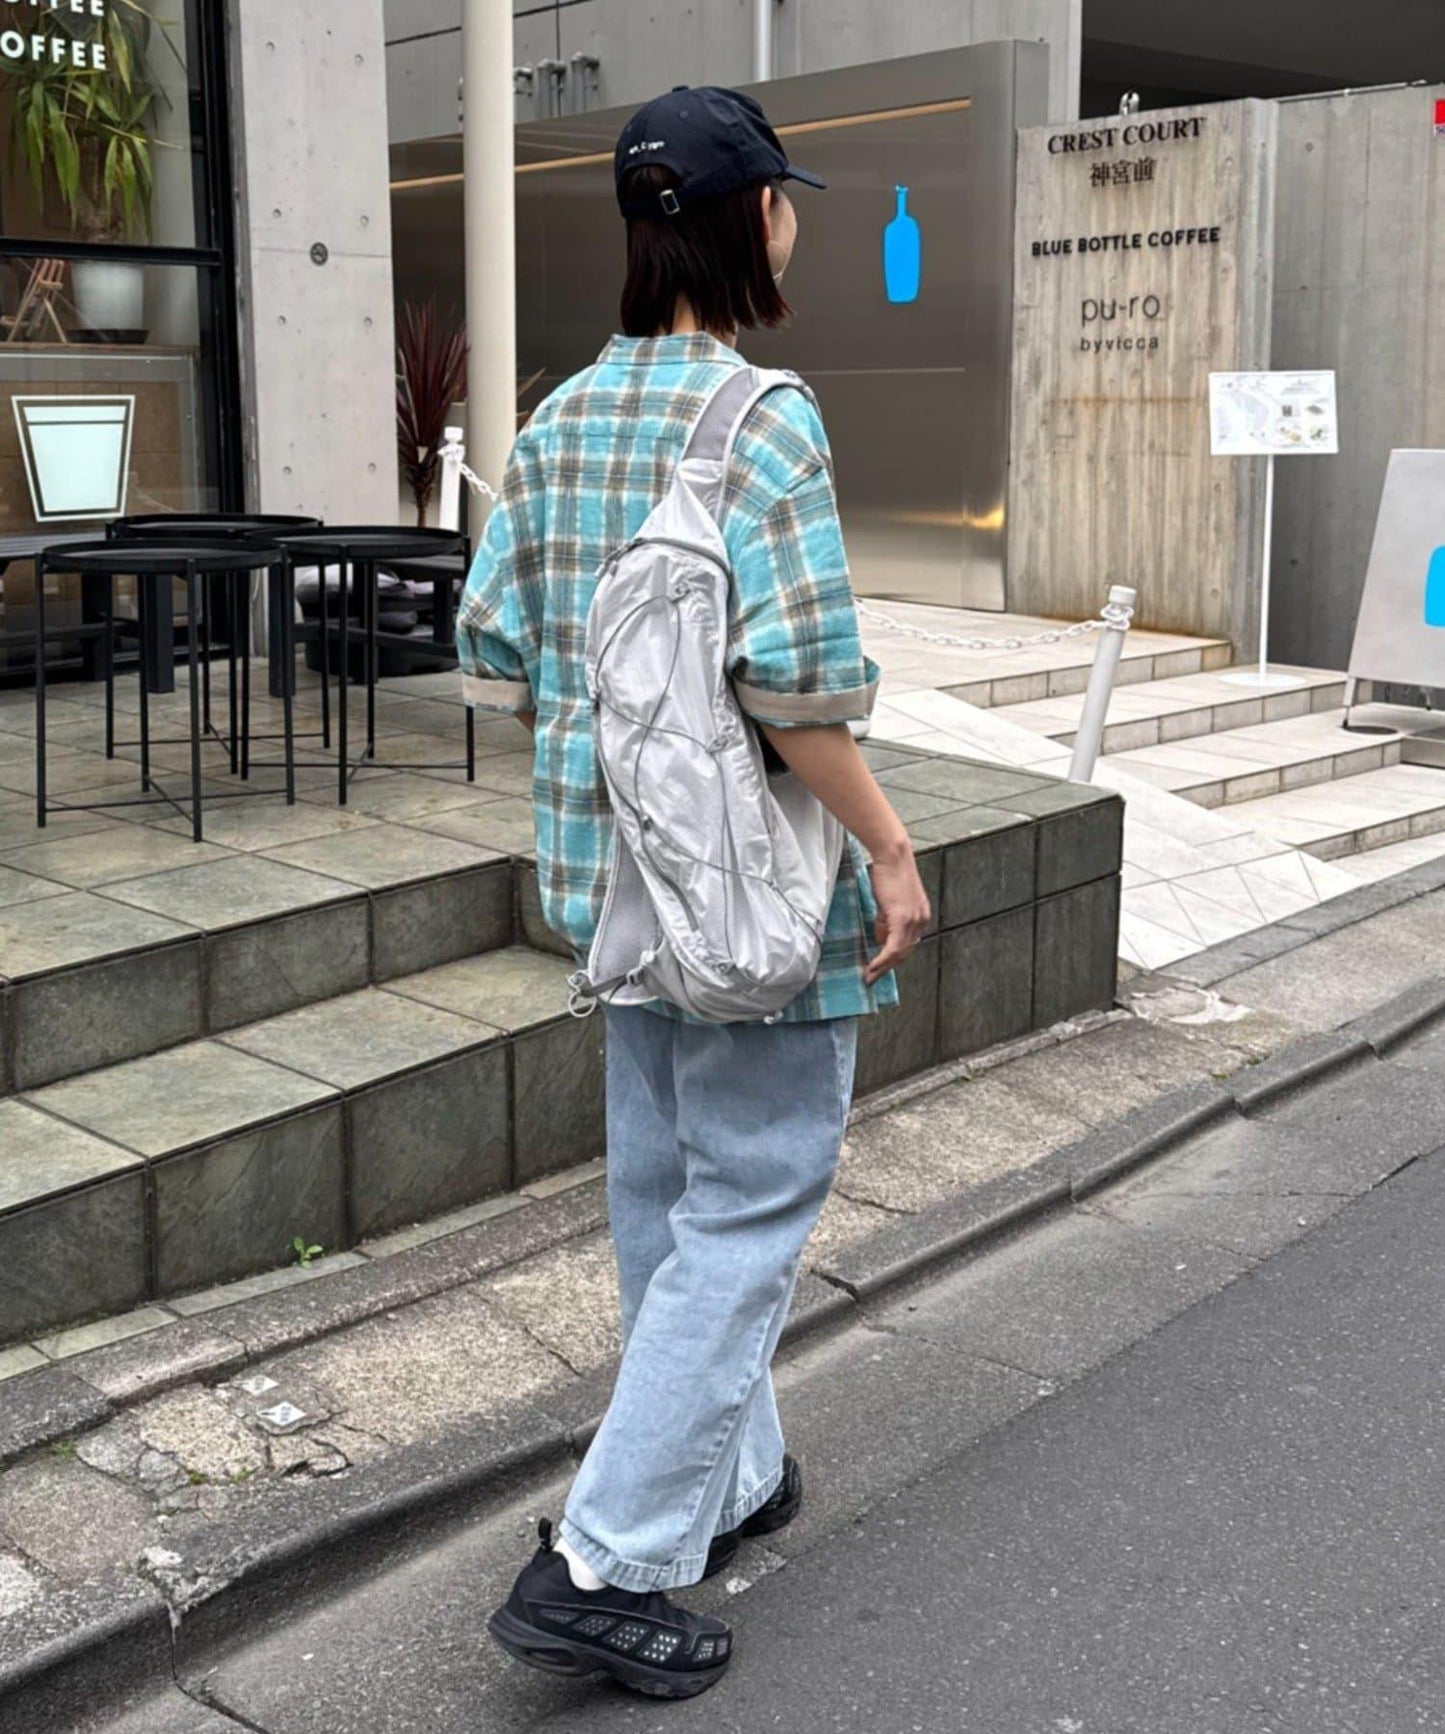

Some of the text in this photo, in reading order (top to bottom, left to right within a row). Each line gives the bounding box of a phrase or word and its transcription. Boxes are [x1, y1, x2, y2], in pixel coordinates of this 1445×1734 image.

[1047, 117, 1207, 154] CREST COURT
[1090, 157, 1158, 187] 神宮前
[1031, 227, 1220, 257] BLUE BOTTLE COFFEE
[1081, 295, 1160, 328] pu-ro
